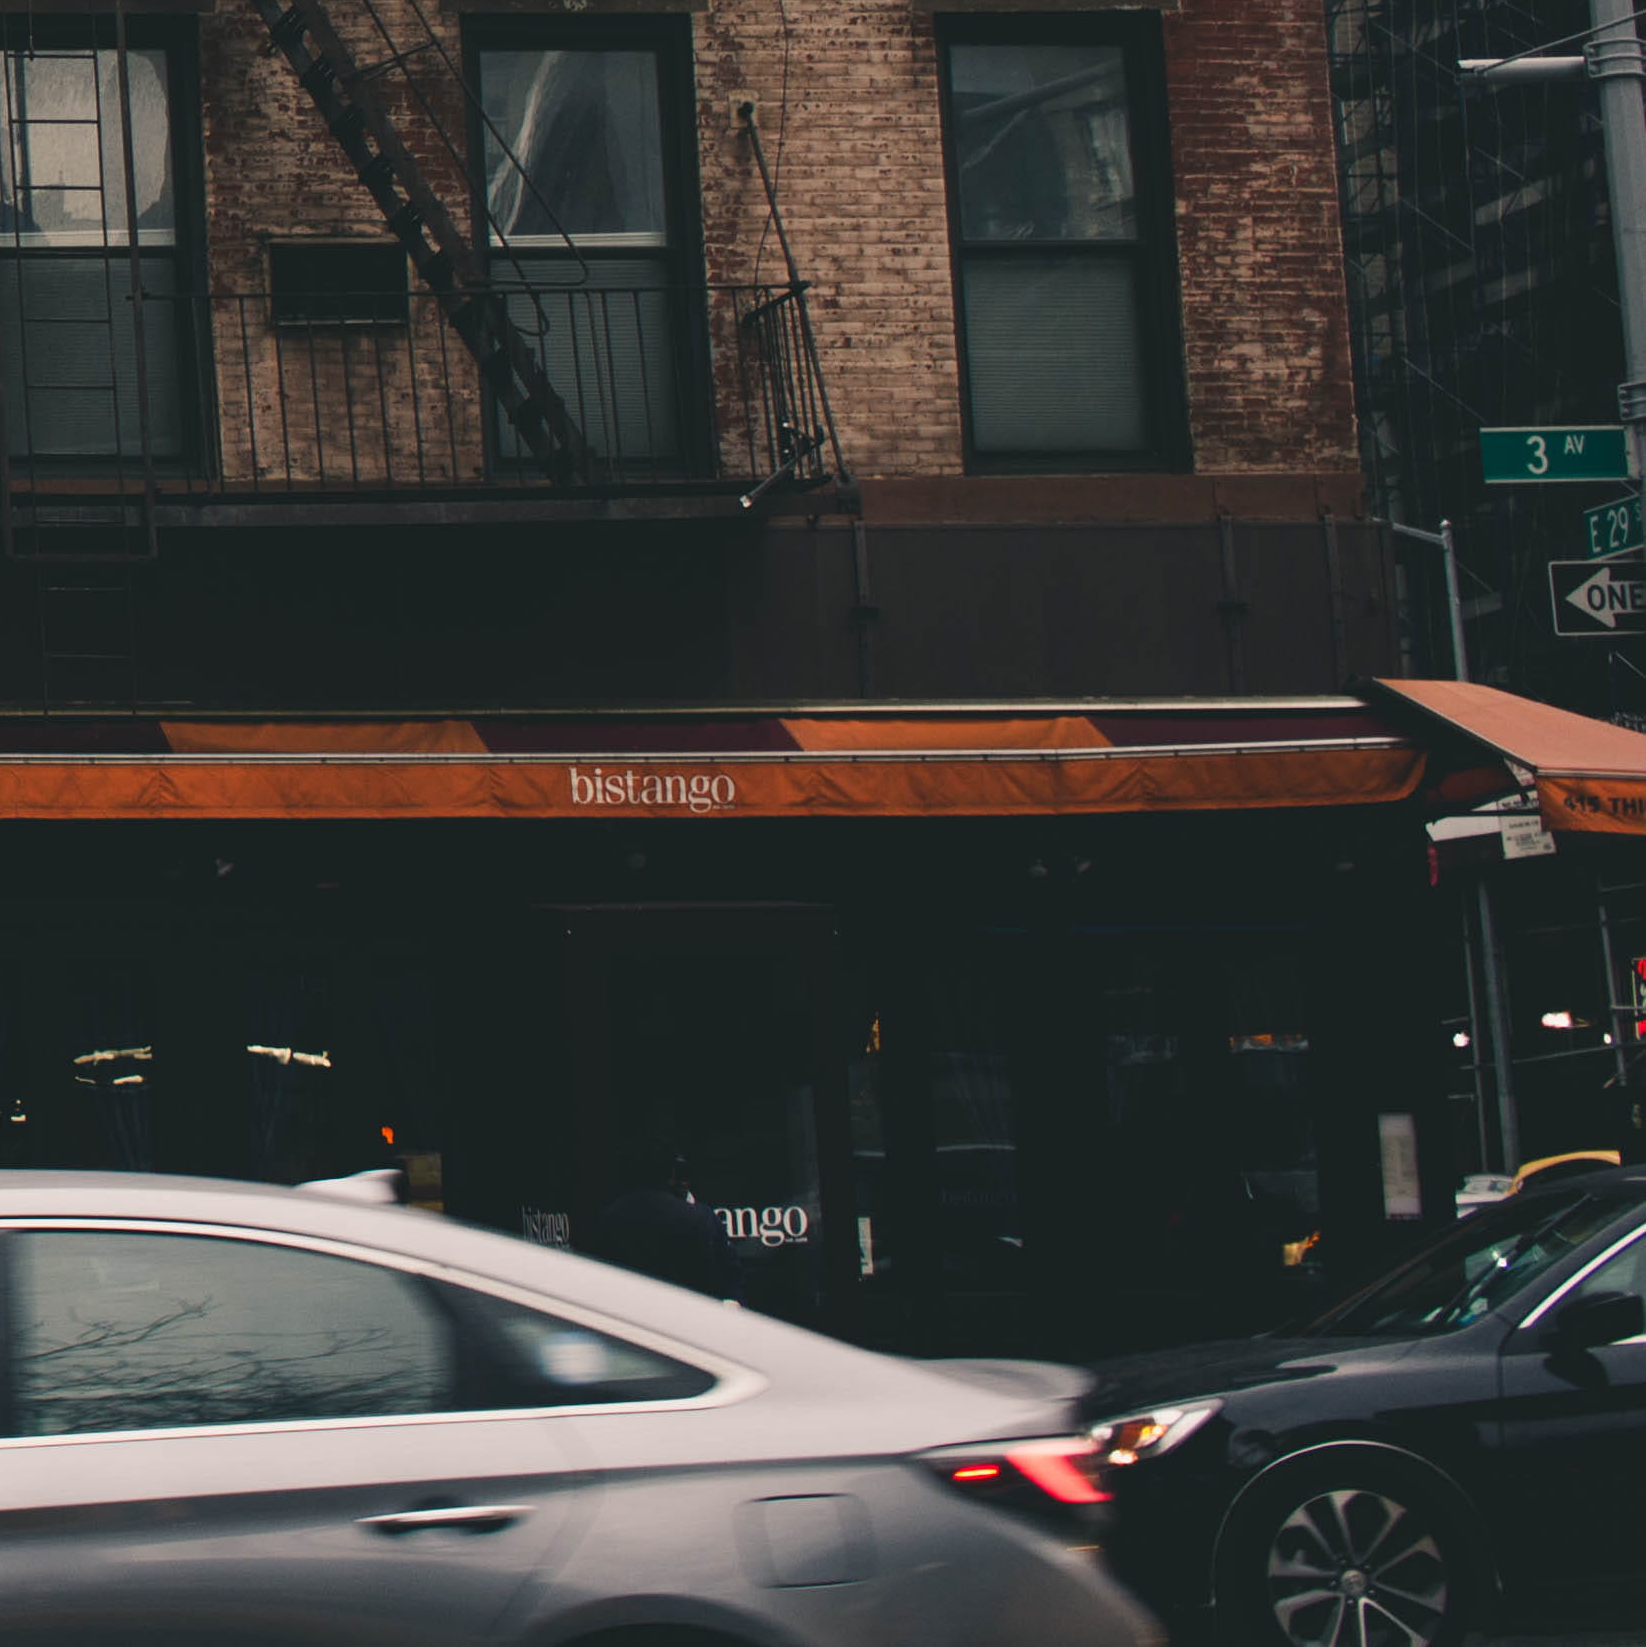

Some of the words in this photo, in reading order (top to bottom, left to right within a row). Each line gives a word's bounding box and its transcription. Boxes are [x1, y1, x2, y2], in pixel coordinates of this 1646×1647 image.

[1526, 435, 1548, 474] 3
[1564, 434, 1585, 454] AV
[1589, 515, 1602, 553] E
[1607, 506, 1629, 548] 29
[1587, 584, 1645, 612] ONE
[568, 767, 736, 814] bistango
